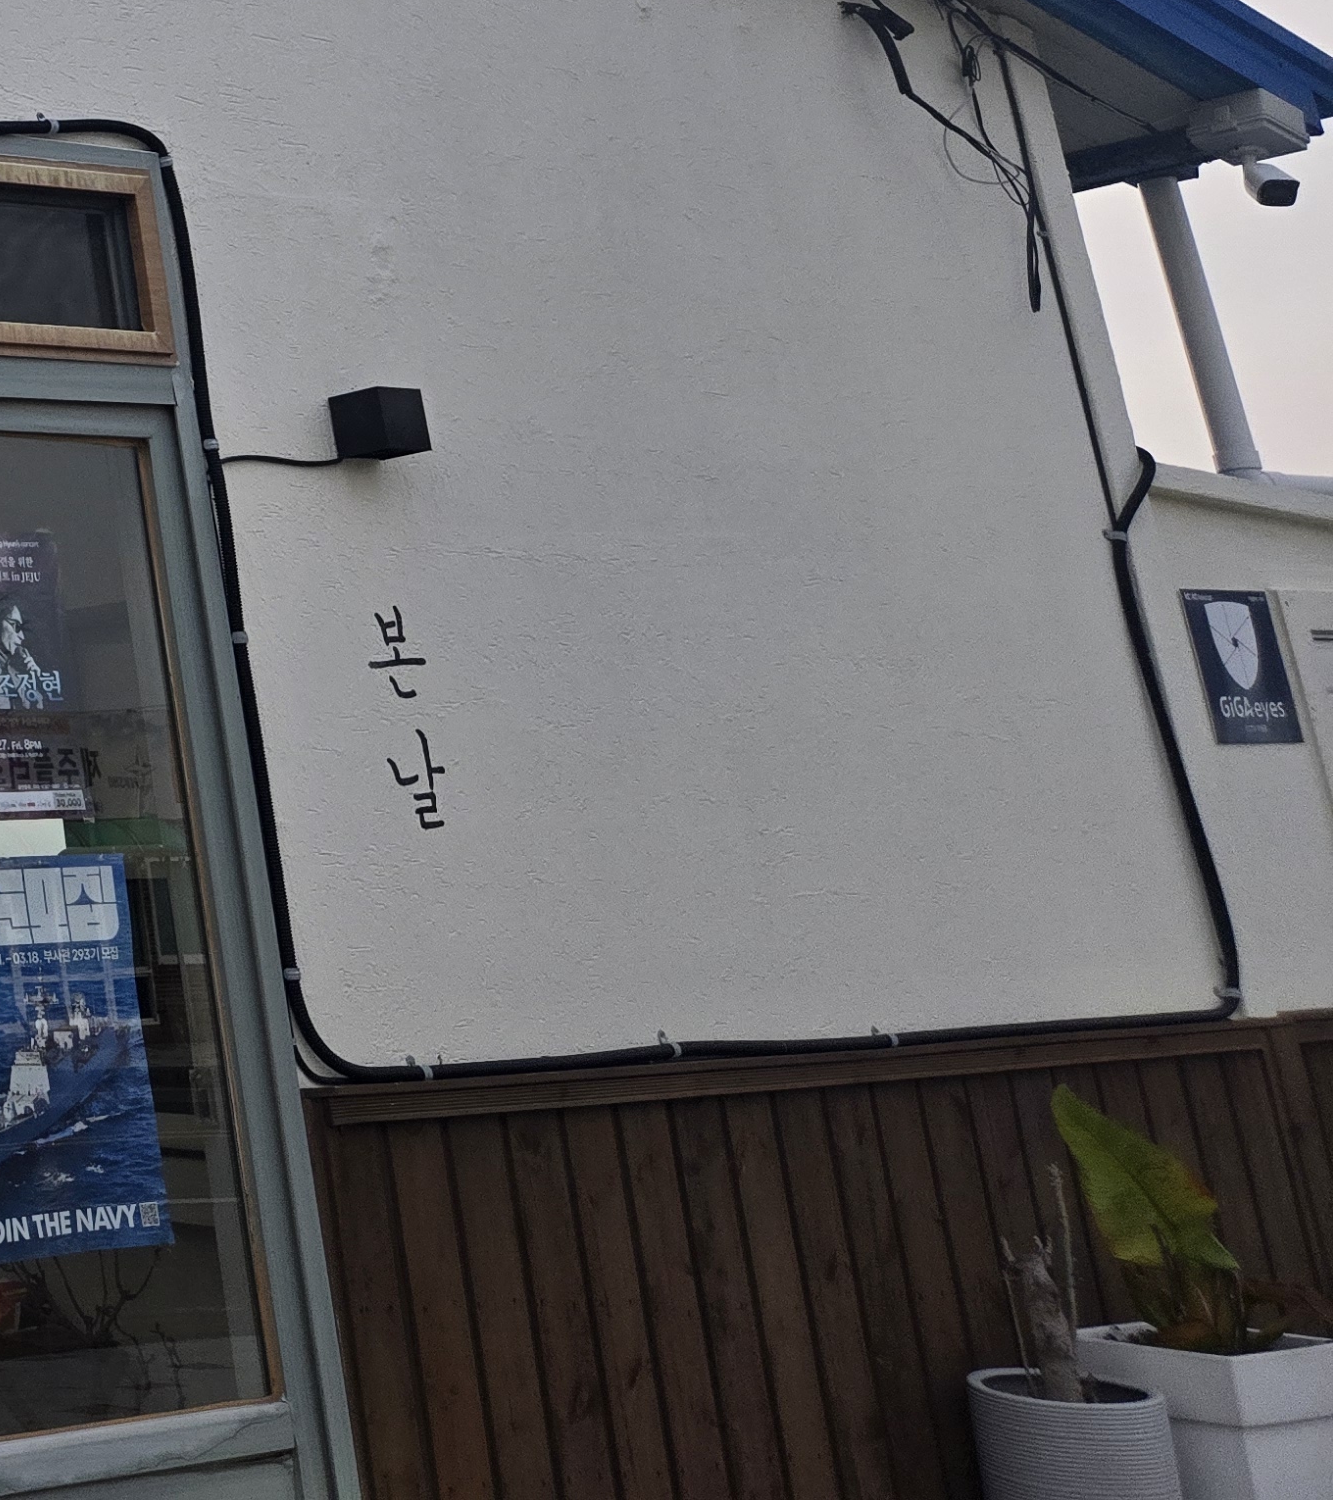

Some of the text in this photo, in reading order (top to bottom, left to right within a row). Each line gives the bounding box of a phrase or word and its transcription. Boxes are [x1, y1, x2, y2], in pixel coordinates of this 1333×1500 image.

[17, 555, 34, 568] 위한
[11, 570, 20, 582] in
[20, 571, 41, 583] JEJU
[368, 605, 445, 830] 본날
[24, 739, 42, 750] 8PM
[72, 947, 100, 962] 293기
[101, 946, 120, 961] 모집
[32, 1210, 72, 1239] THE
[76, 1203, 138, 1233] NAVY
